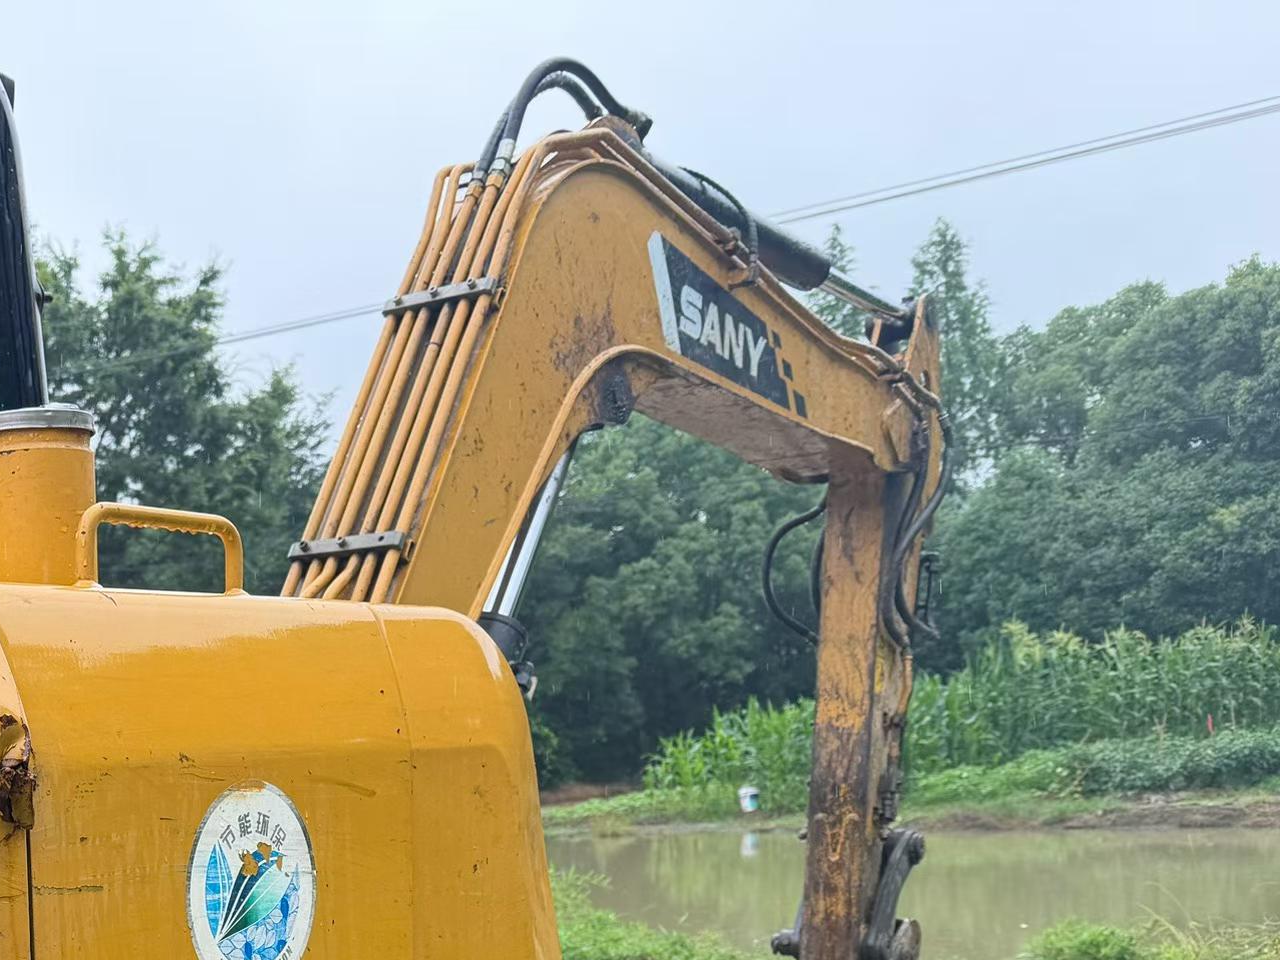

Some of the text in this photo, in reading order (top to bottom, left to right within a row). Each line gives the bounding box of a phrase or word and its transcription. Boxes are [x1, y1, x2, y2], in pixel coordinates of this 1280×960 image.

[679, 285, 767, 377] SANY
[220, 811, 286, 851] 节能环保
